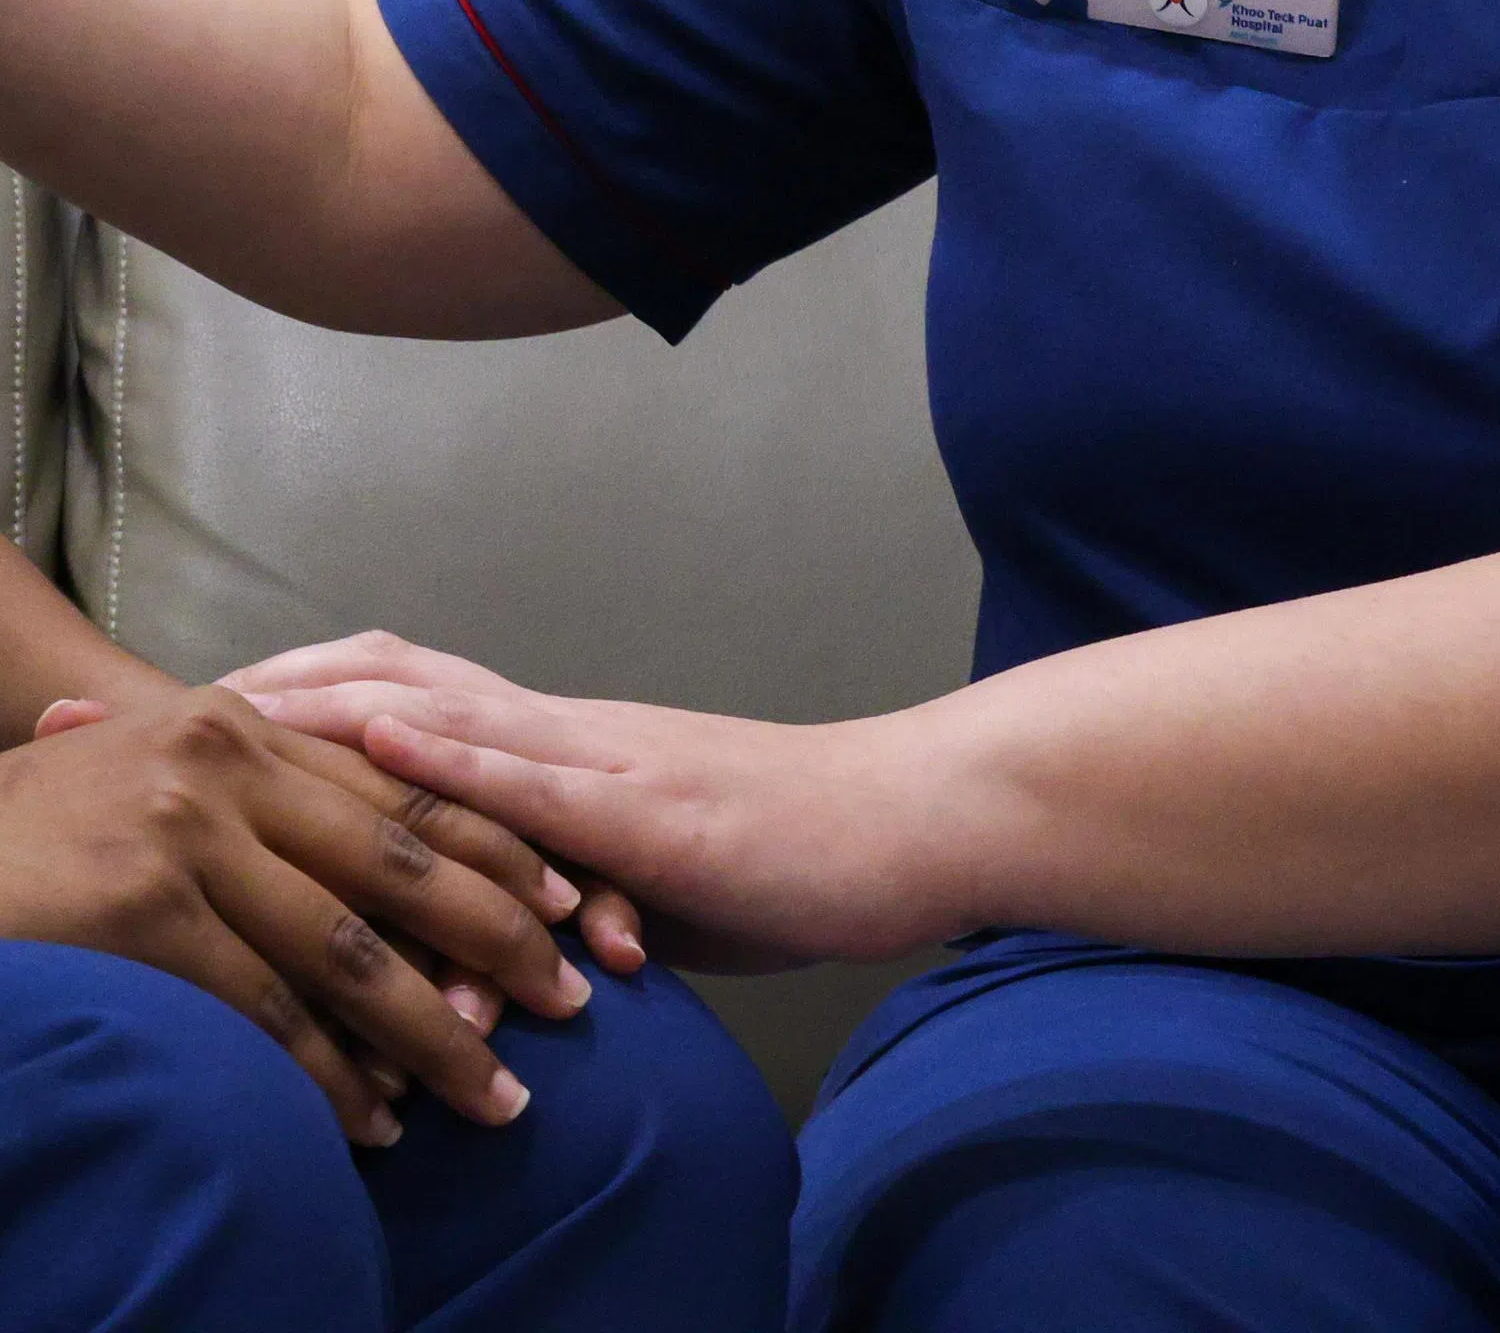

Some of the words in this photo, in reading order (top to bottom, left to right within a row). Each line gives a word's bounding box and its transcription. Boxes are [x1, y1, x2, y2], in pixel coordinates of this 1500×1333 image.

[1231, 16, 1283, 34] Hospital
[1232, 4, 1265, 19] Khoo
[1267, 8, 1295, 24] Teck
[1298, 14, 1329, 29] Puat
